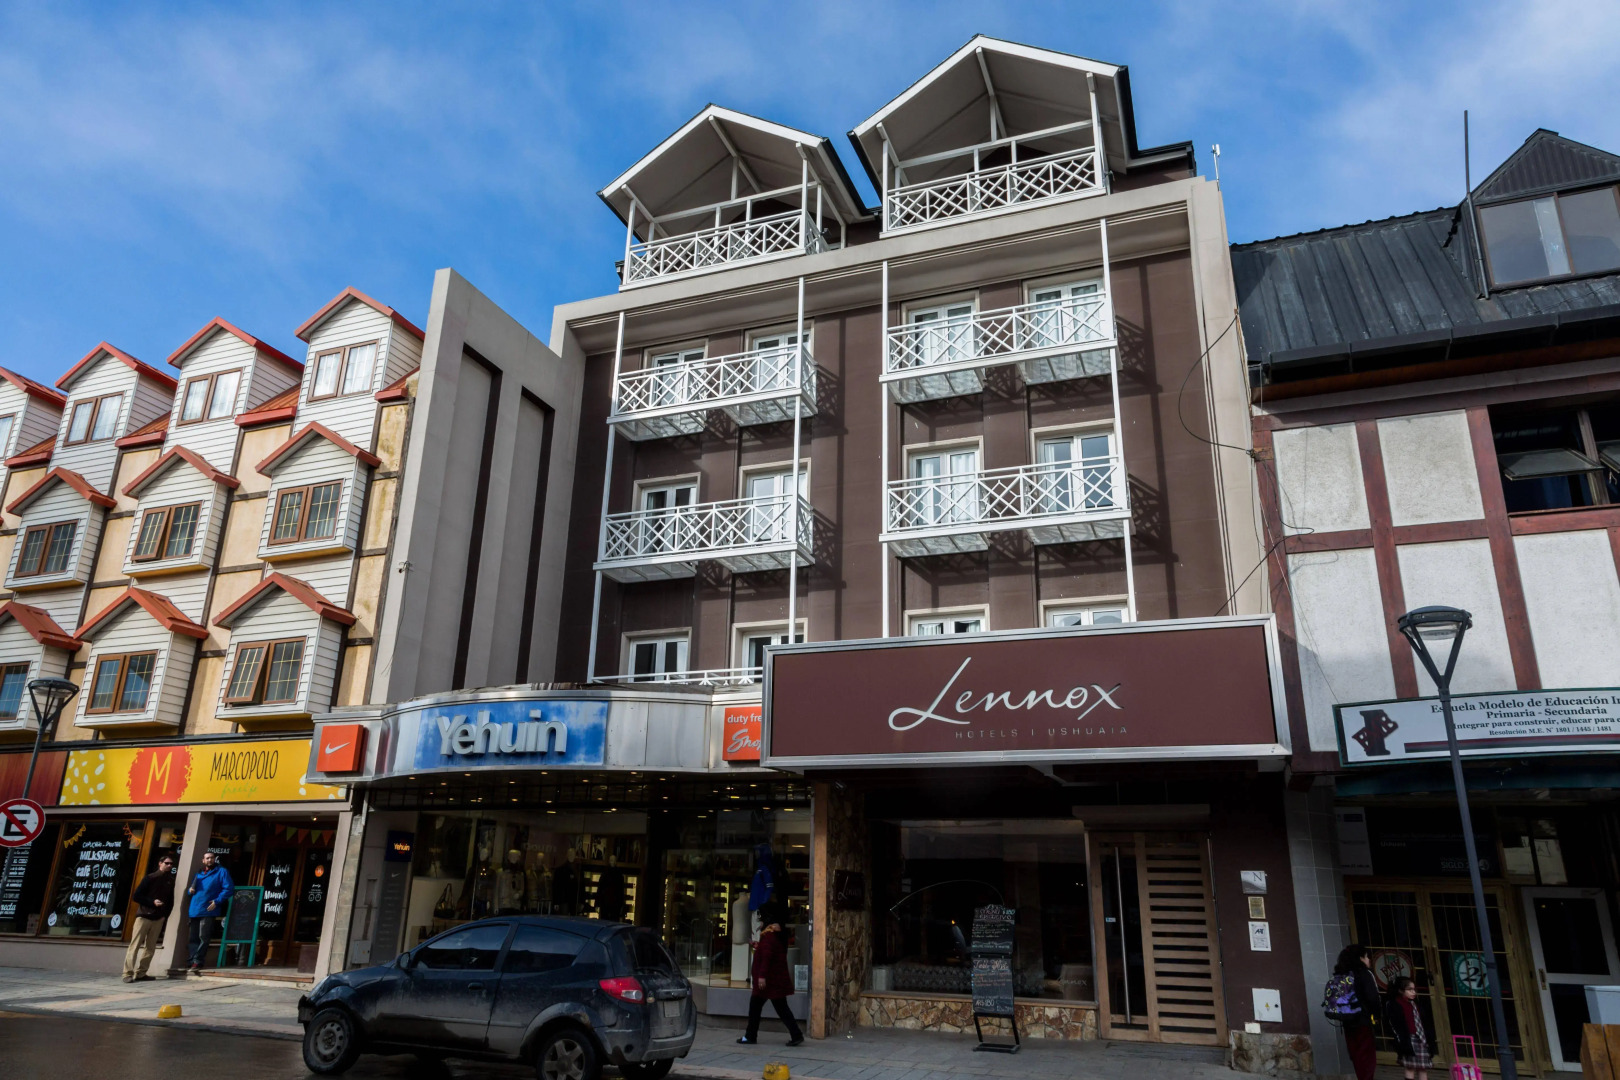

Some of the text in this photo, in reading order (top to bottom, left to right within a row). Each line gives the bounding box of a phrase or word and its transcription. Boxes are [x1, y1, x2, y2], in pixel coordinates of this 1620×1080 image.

[888, 656, 1124, 731] Lennox
[1430, 702, 1475, 713] Esuela
[1479, 700, 1523, 710] Modelo
[1527, 698, 1541, 707] de
[1545, 695, 1609, 706] Educación
[727, 713, 762, 725] duty fre
[1486, 709, 1535, 719] Primaria
[1544, 706, 1607, 716] Secundaria
[1453, 722, 1489, 731] Integrar
[1492, 721, 1511, 729] para
[1514, 717, 1558, 727] construir,
[436, 709, 568, 756] Yehuin
[956, 729, 1018, 739] HOTELS
[1048, 726, 1128, 737] USHUAIA
[1489, 727, 1527, 736] Resolución
[210, 750, 279, 781] MARCOPOLO
[145, 751, 173, 796] M
[3, 809, 31, 836] E
[69, 890, 86, 903] cake
[98, 905, 107, 915] tea
